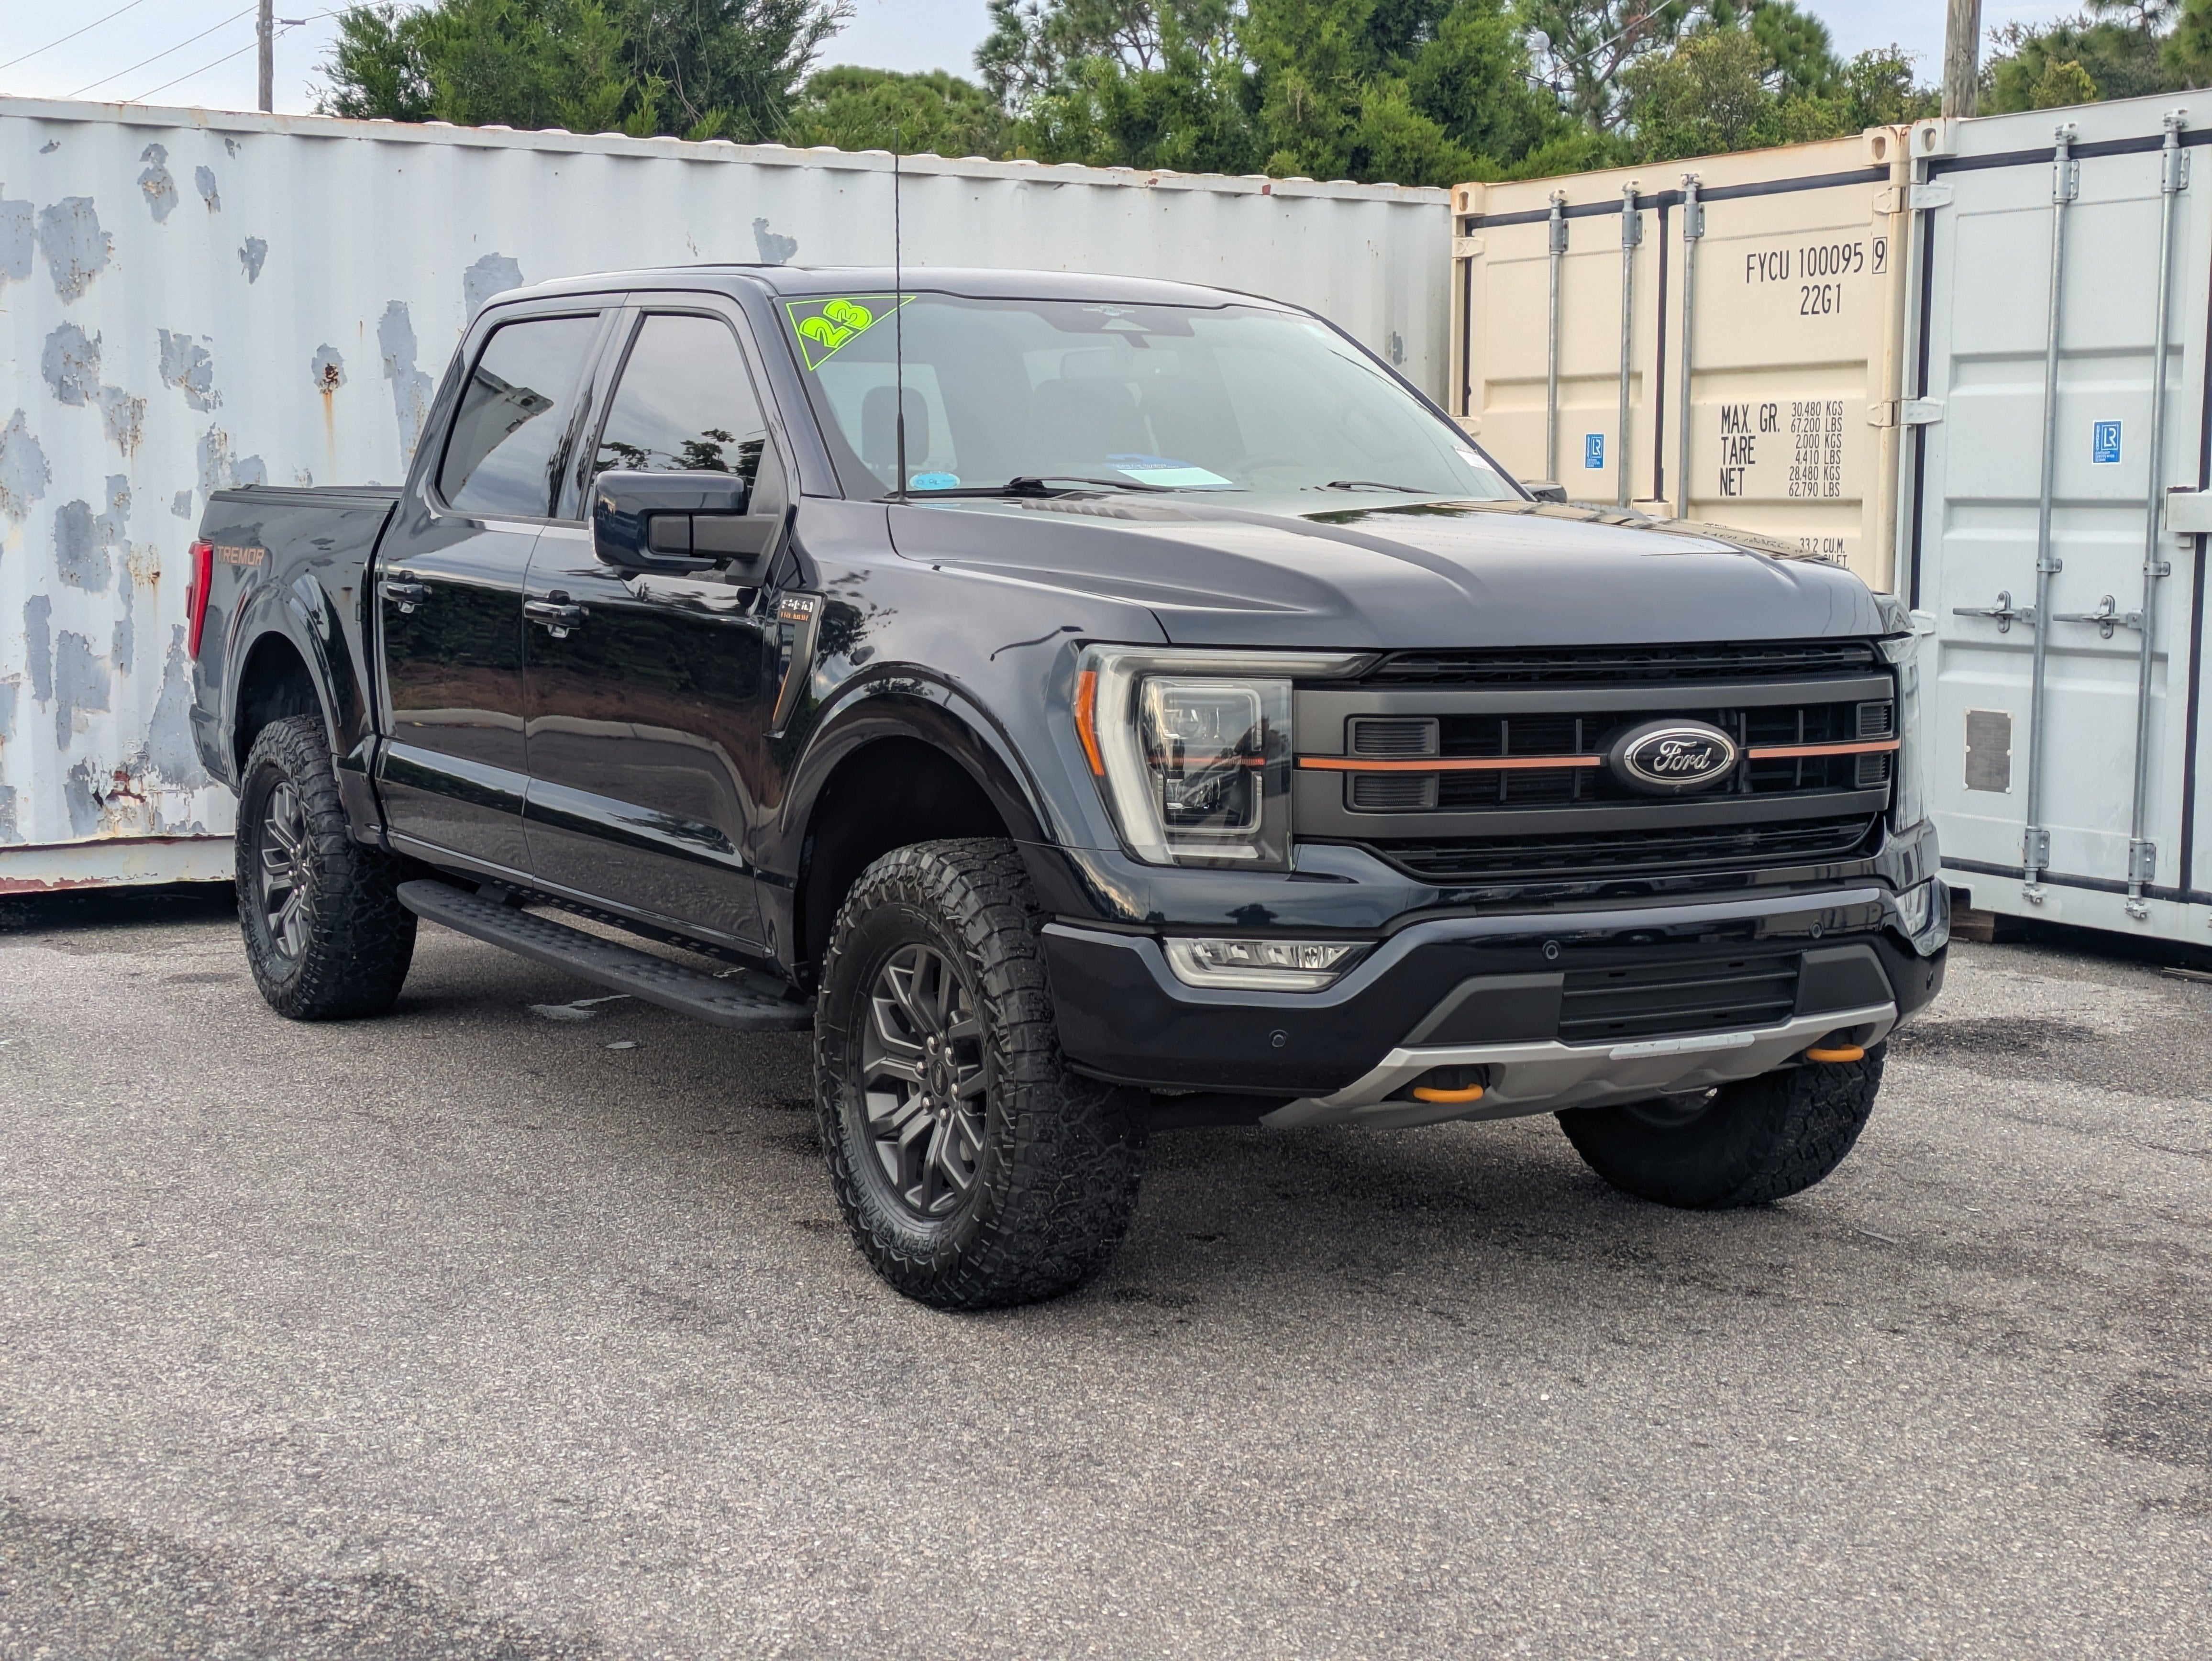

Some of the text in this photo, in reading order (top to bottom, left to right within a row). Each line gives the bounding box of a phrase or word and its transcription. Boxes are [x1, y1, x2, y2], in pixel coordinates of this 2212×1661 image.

[1747, 240, 1886, 284] FYCU 100095 9
[1800, 283, 1841, 315] 22G1
[799, 299, 873, 348] 23
[1721, 403, 1780, 434] MAX. GR.
[1826, 401, 1843, 416] KGS
[1825, 417, 1842, 432] LBS
[1721, 435, 1756, 465] TARE
[1825, 433, 1841, 448] KGS
[1824, 450, 1841, 465] LBS
[1720, 467, 1745, 496] NET
[1824, 466, 1840, 481] KGS
[1824, 482, 1840, 497] LBS
[217, 544, 265, 566] TREMOR
[1800, 538, 1818, 553] 332
[1653, 741, 1712, 772] Ford
